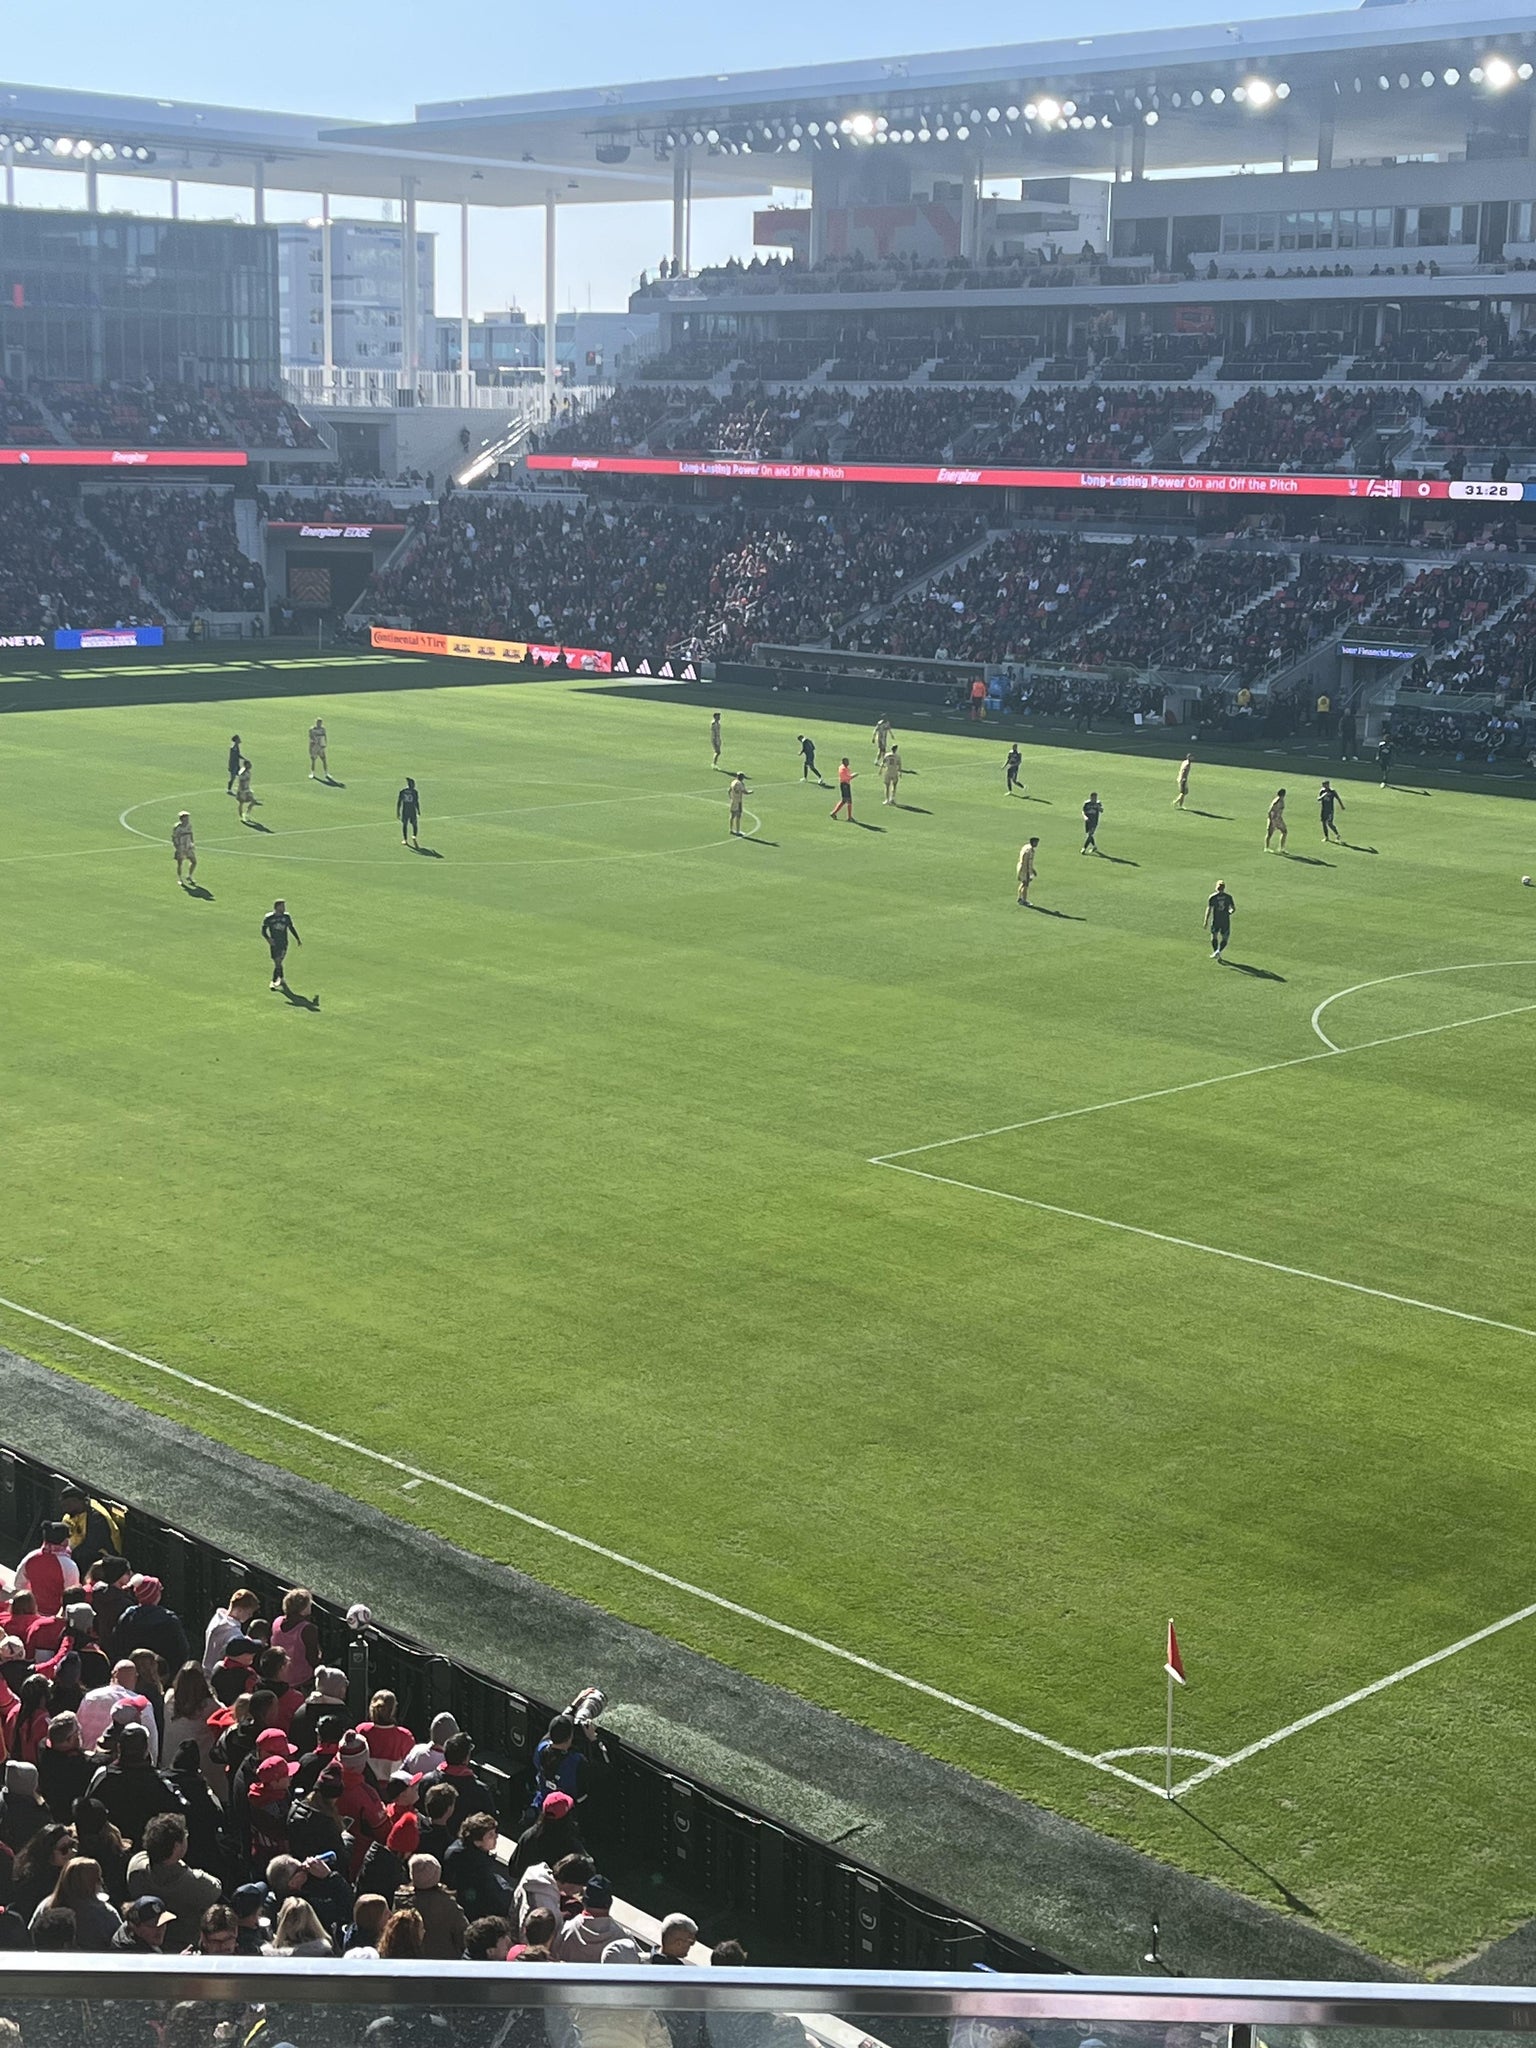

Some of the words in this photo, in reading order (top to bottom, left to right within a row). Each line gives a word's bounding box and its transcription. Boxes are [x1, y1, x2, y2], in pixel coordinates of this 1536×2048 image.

[679, 461, 731, 476] Long-Lasting
[733, 463, 760, 475] Power
[761, 465, 773, 475] On
[774, 465, 791, 477] and
[792, 465, 805, 477] Off
[807, 466, 821, 477] the
[822, 467, 844, 479] Pitch
[937, 467, 982, 484] Energizer
[1080, 473, 1148, 489] Long-Lasting
[1150, 474, 1185, 488] Power
[1188, 475, 1203, 488] On
[1205, 475, 1226, 489] and
[1229, 477, 1246, 490] Off
[1249, 478, 1266, 490] the
[1269, 478, 1298, 492] Pitch
[1464, 485, 1509, 497] 31:28
[343, 527, 373, 538] EDGE
[0, 635, 46, 647] NETA
[373, 631, 419, 646] Continental
[427, 636, 446, 648] Tire
[1358, 647, 1390, 657] Financial
